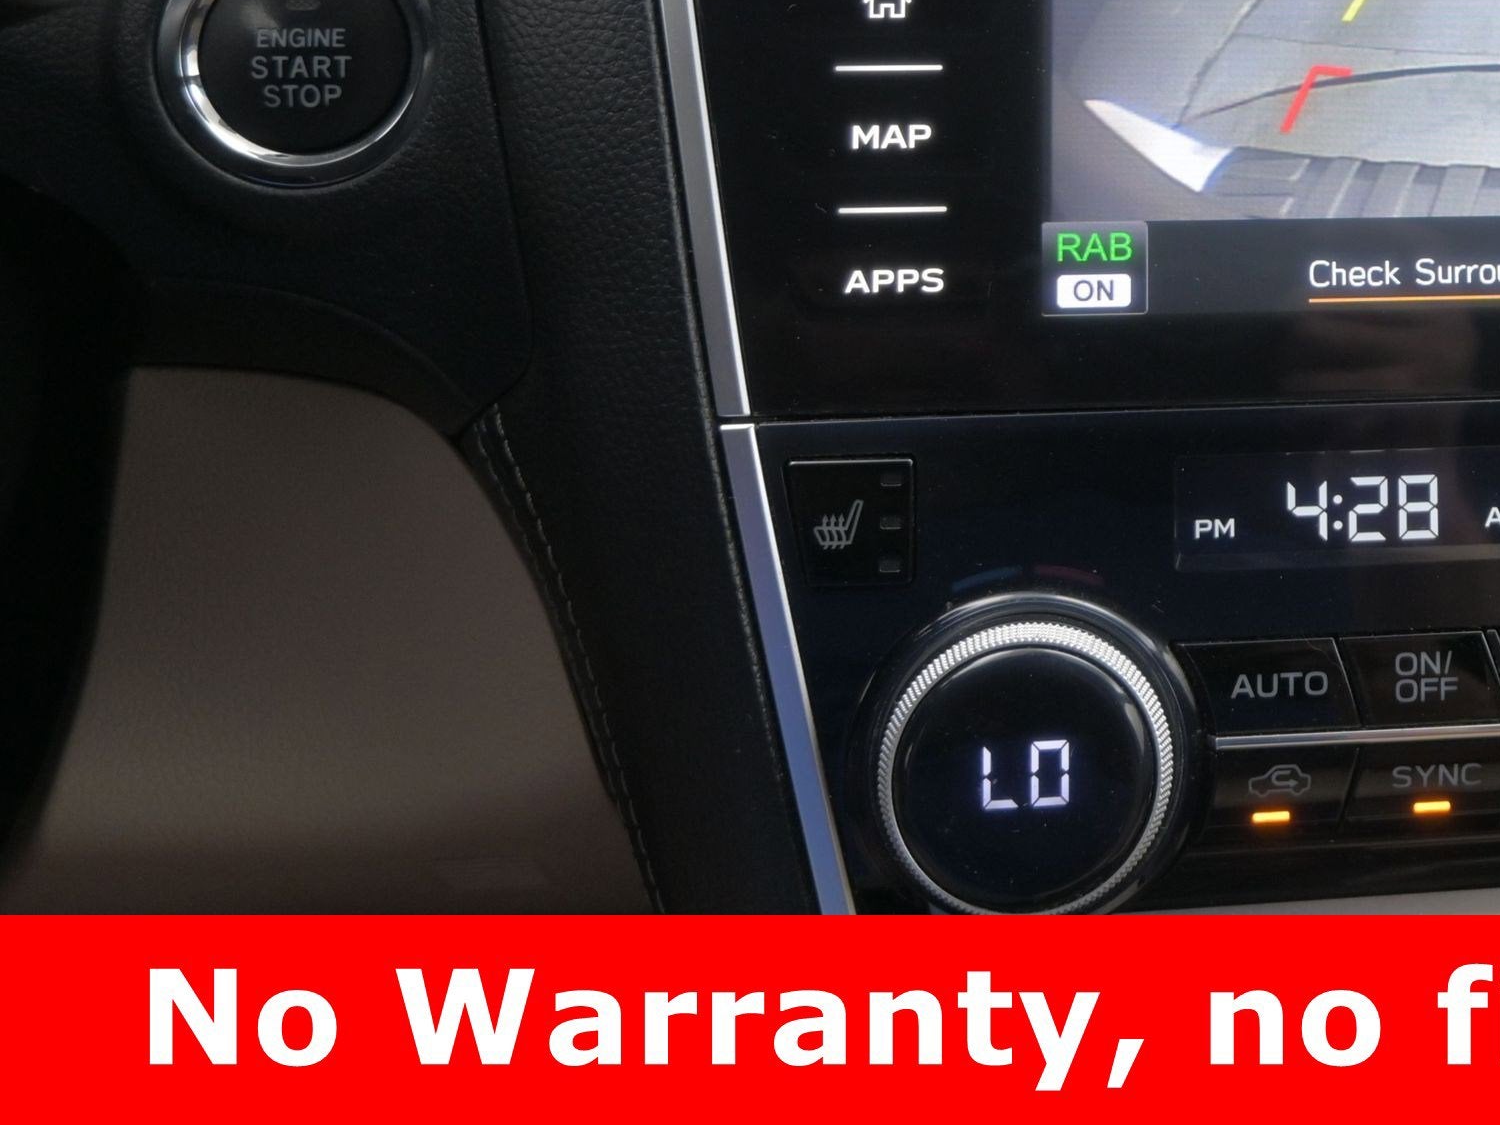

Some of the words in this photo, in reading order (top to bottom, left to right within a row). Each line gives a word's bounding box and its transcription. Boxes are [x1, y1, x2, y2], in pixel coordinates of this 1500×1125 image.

[256, 28, 346, 49] ENGINE
[250, 55, 352, 80] START
[263, 84, 343, 108] STOP
[851, 125, 932, 150] MAP
[1056, 232, 1133, 262] RAB
[845, 268, 945, 293] APPS
[1309, 260, 1401, 287] Check
[1073, 280, 1115, 301] ON
[1286, 474, 1438, 542] 4:28
[1194, 518, 1235, 539] PM
[1395, 650, 1453, 675] ON/
[1231, 671, 1329, 699] AUTO
[1395, 676, 1458, 703] OFF
[1391, 762, 1484, 788] SYNC
